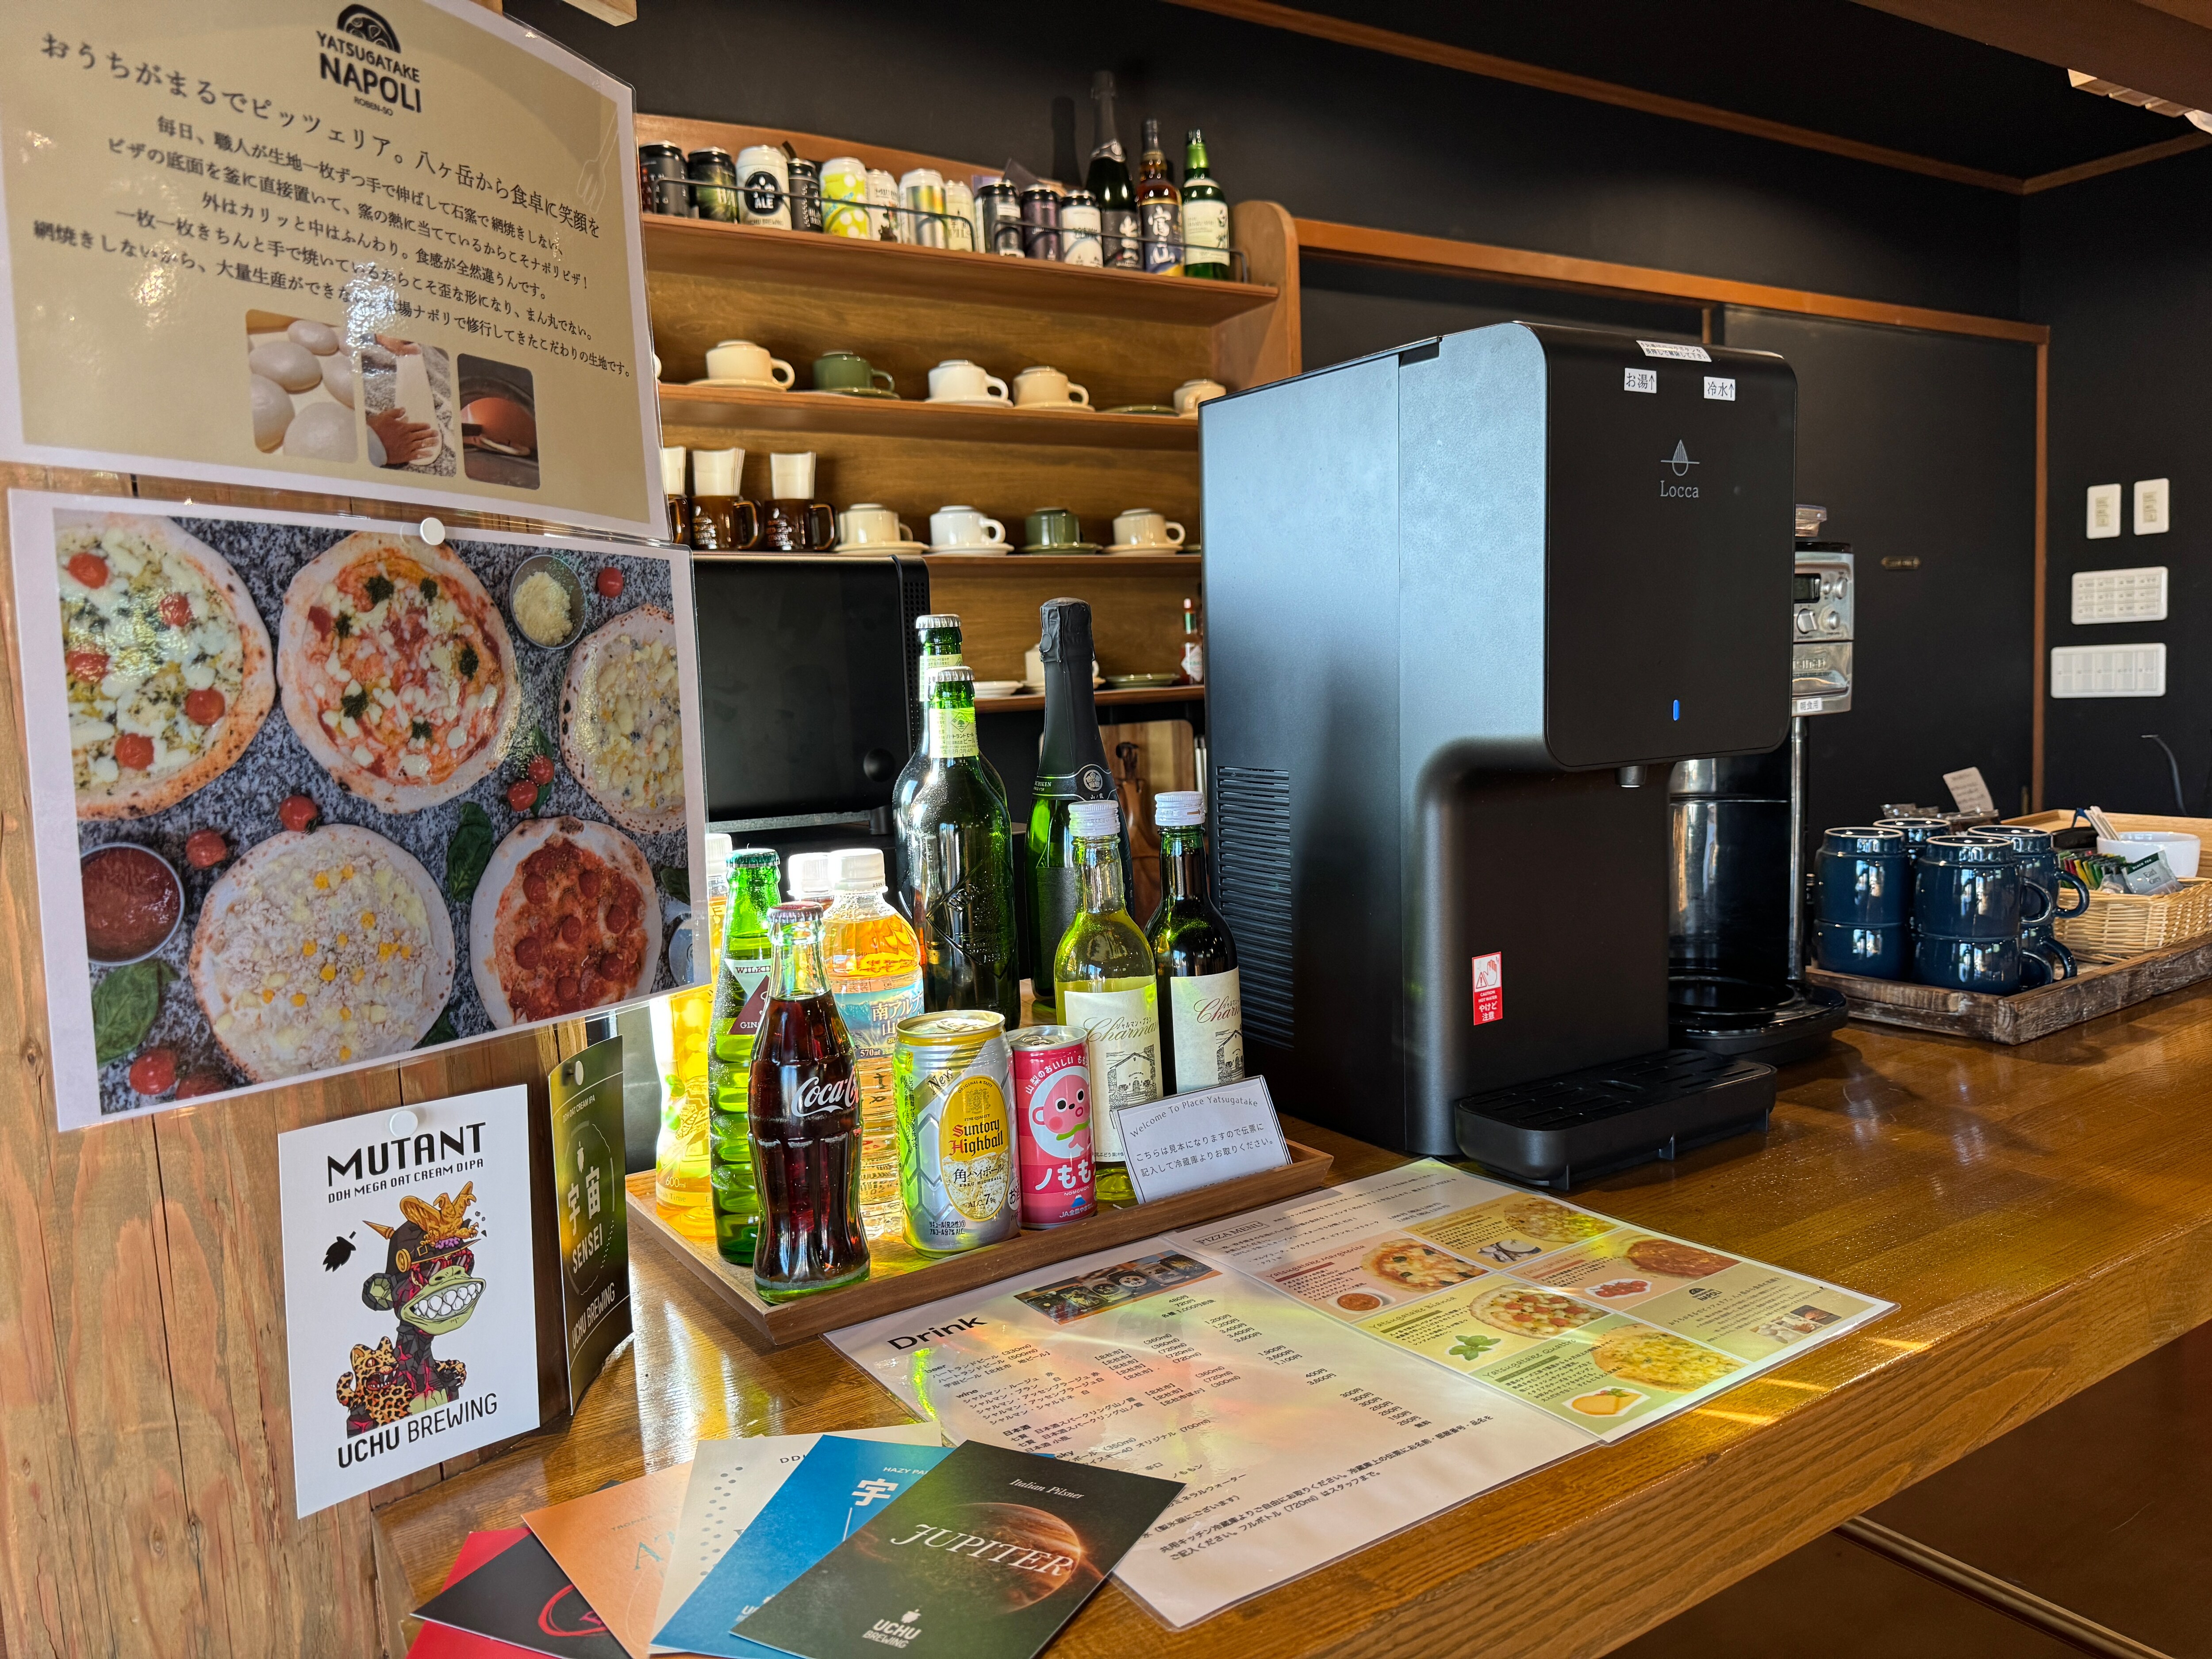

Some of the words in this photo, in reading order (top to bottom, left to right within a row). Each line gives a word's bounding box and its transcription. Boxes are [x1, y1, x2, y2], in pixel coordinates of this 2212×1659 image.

[316, 30, 421, 83] YATSUGATAKE
[319, 53, 422, 113] NAPOLI
[755, 197, 774, 209] ALE
[1626, 373, 1648, 389] お湯
[1707, 382, 1728, 397] 冷水
[1660, 480, 1699, 498] Locca
[1479, 1001, 1498, 1012] やけど
[1482, 1011, 1495, 1022] 注意
[926, 1068, 954, 1094] New
[1025, 1056, 1073, 1095] 山梨のおいしい
[958, 1080, 979, 1093] ORIGINAL
[577, 1099, 589, 1115] CREAM
[1130, 1111, 1167, 1138] Welcome
[1168, 1105, 1179, 1114] To
[1182, 1098, 1204, 1109] Place
[1206, 1095, 1258, 1107] Yatsugatake
[952, 1119, 1000, 1139] Suntory
[949, 1133, 1003, 1157] Highball
[1137, 1123, 1264, 1162] こちらは見本になりますので伝票に
[327, 1122, 486, 1187] MUTANT
[1140, 1137, 1273, 1177] 記入して冷蔵庫よりお取りください。
[328, 1189, 351, 1203] DDH
[355, 1179, 387, 1198] MEGA
[390, 1175, 411, 1188] OAT
[414, 1164, 453, 1182] CREAM
[457, 1158, 484, 1173] DIPA
[665, 1176, 686, 1189] 600ml
[952, 1163, 1004, 1183] 角ハイボール
[567, 1166, 601, 1236] 宇宙
[1197, 1232, 1233, 1244] PIZZA
[1228, 1222, 1266, 1234] MENU
[572, 1222, 603, 1275] SENSEI
[1321, 1244, 1366, 1264] Margherita
[1167, 1294, 1189, 1303] 480円
[1174, 1298, 1197, 1307] 720円
[571, 1318, 587, 1350] UCHU
[587, 1282, 616, 1332] BREWING
[1369, 1305, 1426, 1330] Yatsugatake
[1426, 1295, 1457, 1310] Bianca
[887, 1317, 988, 1350] Drink
[1157, 1342, 1188, 1354] (720ml)
[1218, 1323, 1248, 1333] 3,400円
[1164, 1347, 1195, 1359] (720ml)
[1226, 1327, 1255, 1338] 3,400円
[962, 1377, 1040, 1403] シャルマン・ルージュ
[1142, 1333, 1173, 1344] (360ml)
[1204, 1314, 1232, 1324] 1,200円
[969, 1384, 1040, 1409] シャルマン・ブラン
[1150, 1337, 1181, 1349] (360ml)
[1212, 1318, 1240, 1329] 1,200円
[1482, 1352, 1543, 1379] Yatsugatake
[1542, 1339, 1577, 1355] Quattro
[924, 1364, 948, 1374] beer
[1304, 1368, 1329, 1378] 400円
[955, 1389, 979, 1398] wine
[988, 1394, 1075, 1425] シャルマン・シャルドネ
[1171, 1352, 1202, 1363] (720ml)
[1010, 1433, 1029, 1442] 七賢
[1034, 1397, 1137, 1434] 日本酒スパークリング山ノ霞
[1194, 1366, 1226, 1378] (360ml)
[1257, 1345, 1286, 1356] 1,900円
[1339, 1387, 1364, 1398] 300円
[1349, 1392, 1375, 1402] 300円
[1017, 1439, 1037, 1448] 七賢
[1041, 1402, 1145, 1439] 日本酒スパークリング山ノ霞
[1202, 1371, 1234, 1382] (720ml)
[1025, 1441, 1052, 1453] 日本酒
[1210, 1375, 1242, 1387] (300ml)
[1273, 1354, 1303, 1365] 1,100円
[1357, 1396, 1383, 1407] 300円
[1368, 1401, 1394, 1411] 250円
[1378, 1406, 1403, 1416] 250円
[1387, 1410, 1413, 1421] 150円
[1396, 1415, 1422, 1426] 250円
[1413, 1420, 1432, 1428] 無料
[337, 1427, 399, 1468] UCHU
[407, 1393, 498, 1444] BREWING
[1002, 1424, 1032, 1436] 日本酒
[1135, 1431, 1177, 1448] オリジナル
[1144, 1462, 1164, 1471] 辛口
[1009, 1479, 1046, 1494] Italian
[1045, 1486, 1085, 1500] Pilsner
[890, 1524, 1074, 1577] JUPITER
[862, 1630, 909, 1649] BREWING
[872, 1619, 922, 1640] UCHU
